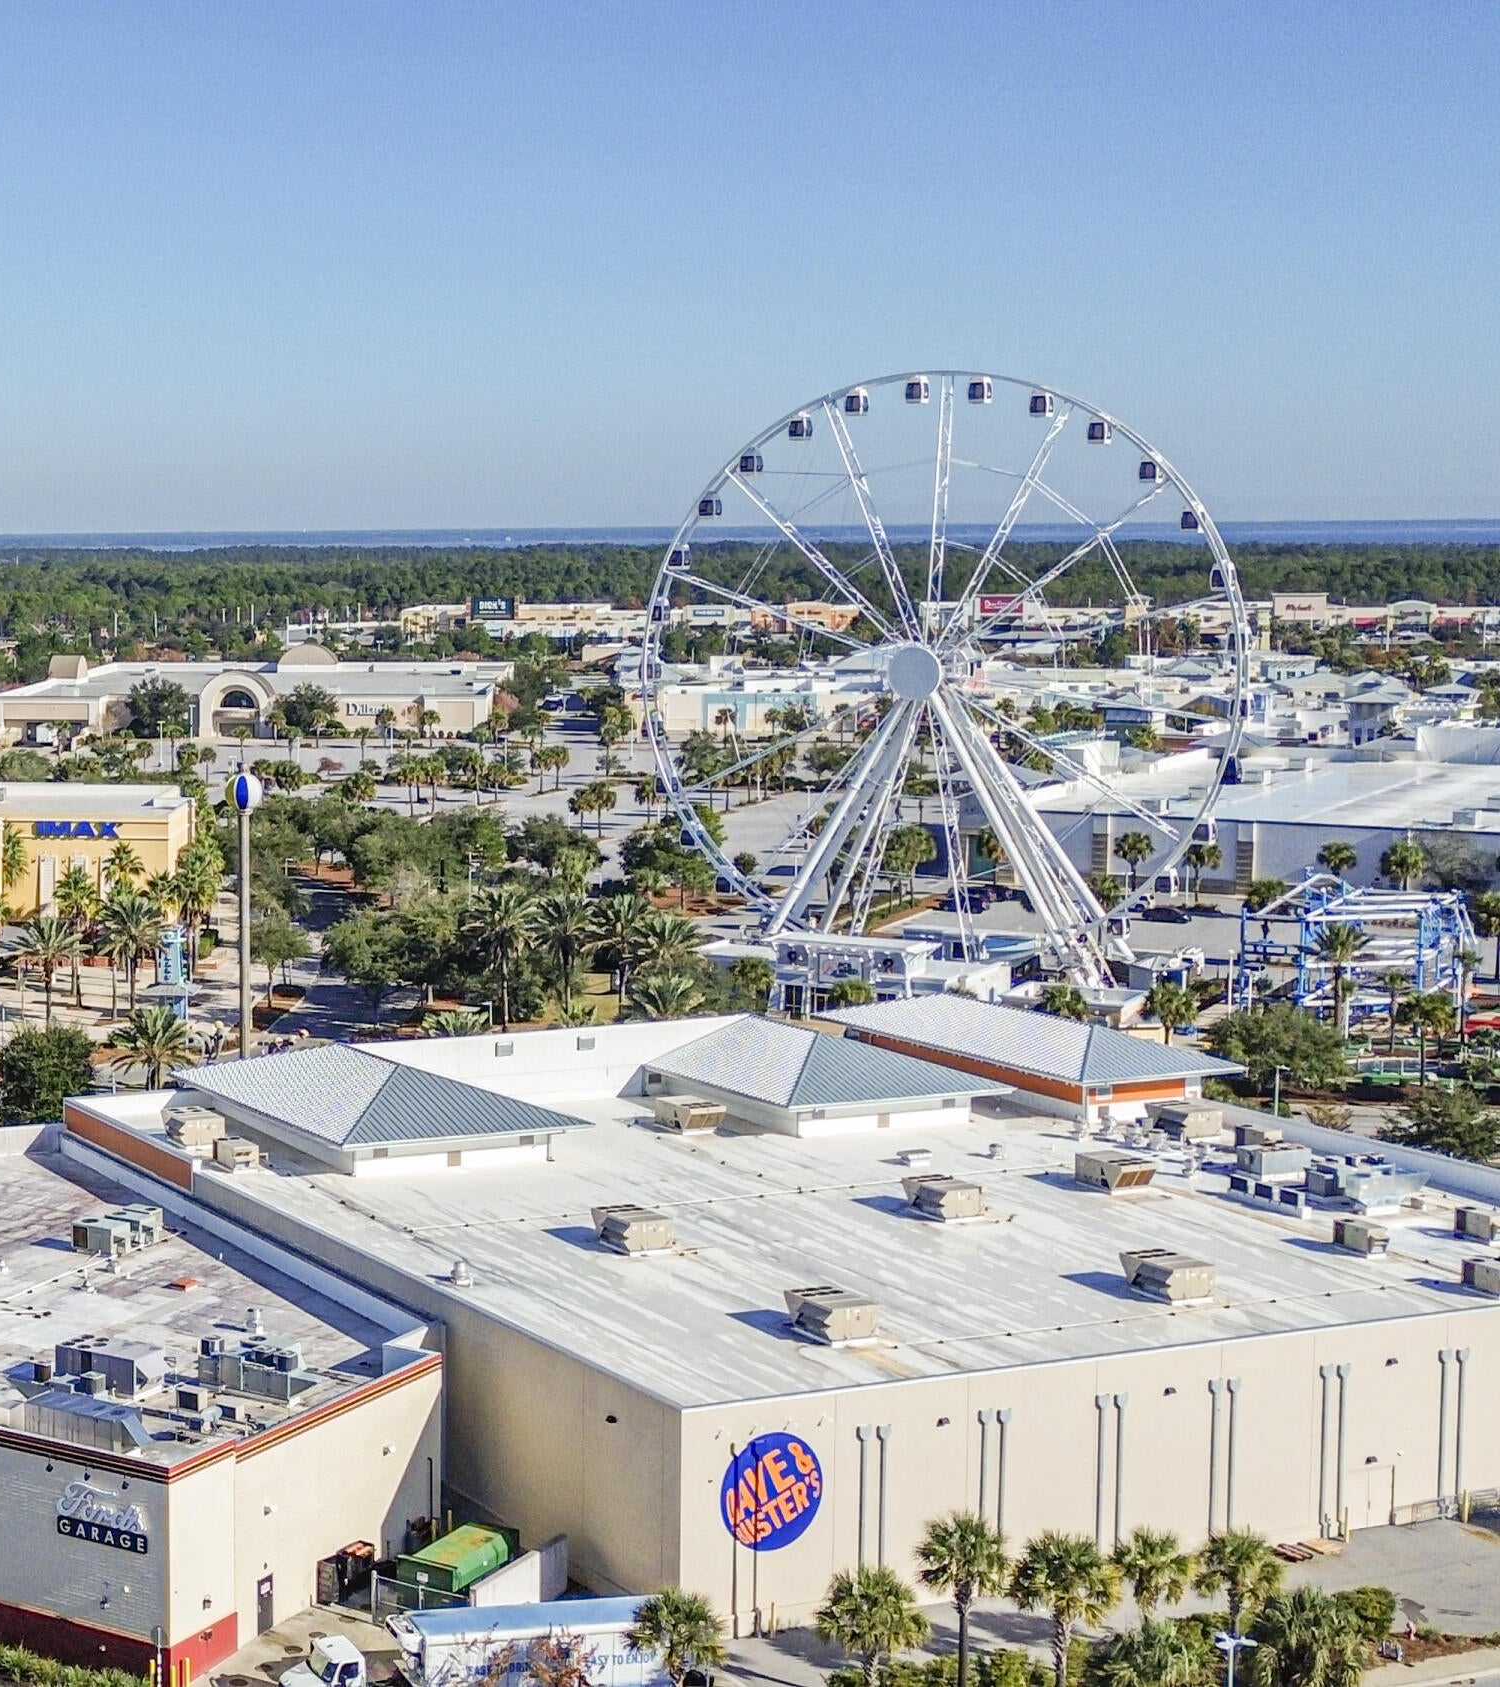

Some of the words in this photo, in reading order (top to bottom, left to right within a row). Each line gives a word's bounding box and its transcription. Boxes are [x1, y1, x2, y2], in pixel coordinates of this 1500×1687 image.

[479, 599, 506, 610] DICK'S
[32, 820, 122, 839] IMAX
[787, 1442, 815, 1474] &
[56, 1481, 148, 1534] Ford's
[59, 1519, 145, 1552] GARAGE
[612, 1653, 623, 1665] TO
